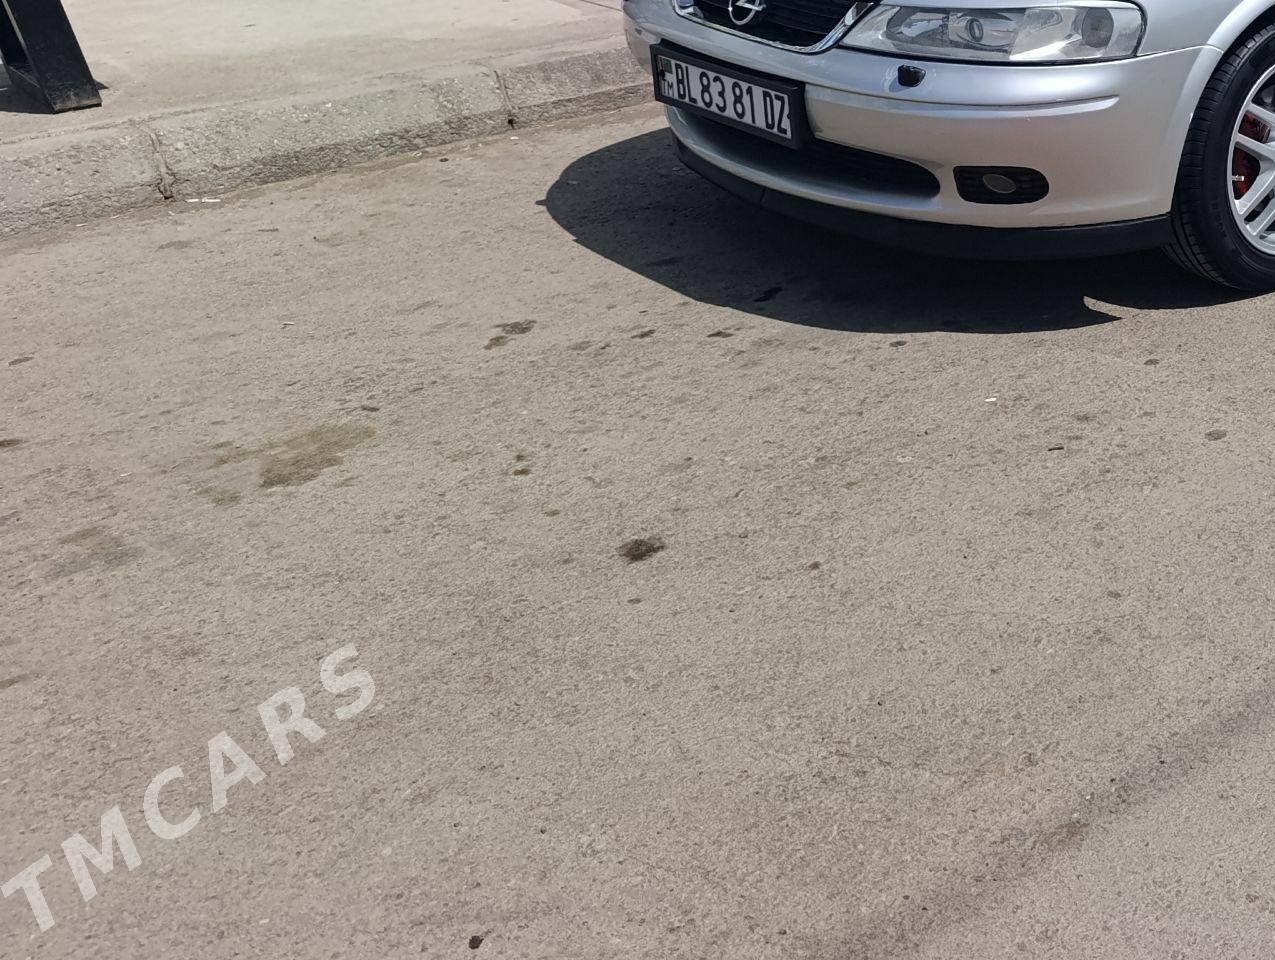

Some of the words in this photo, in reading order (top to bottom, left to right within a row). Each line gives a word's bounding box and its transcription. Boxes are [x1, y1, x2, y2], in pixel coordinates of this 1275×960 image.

[675, 62, 698, 104] BL
[699, 71, 727, 113] 83
[731, 81, 756, 125] 81
[762, 90, 788, 135] DZ
